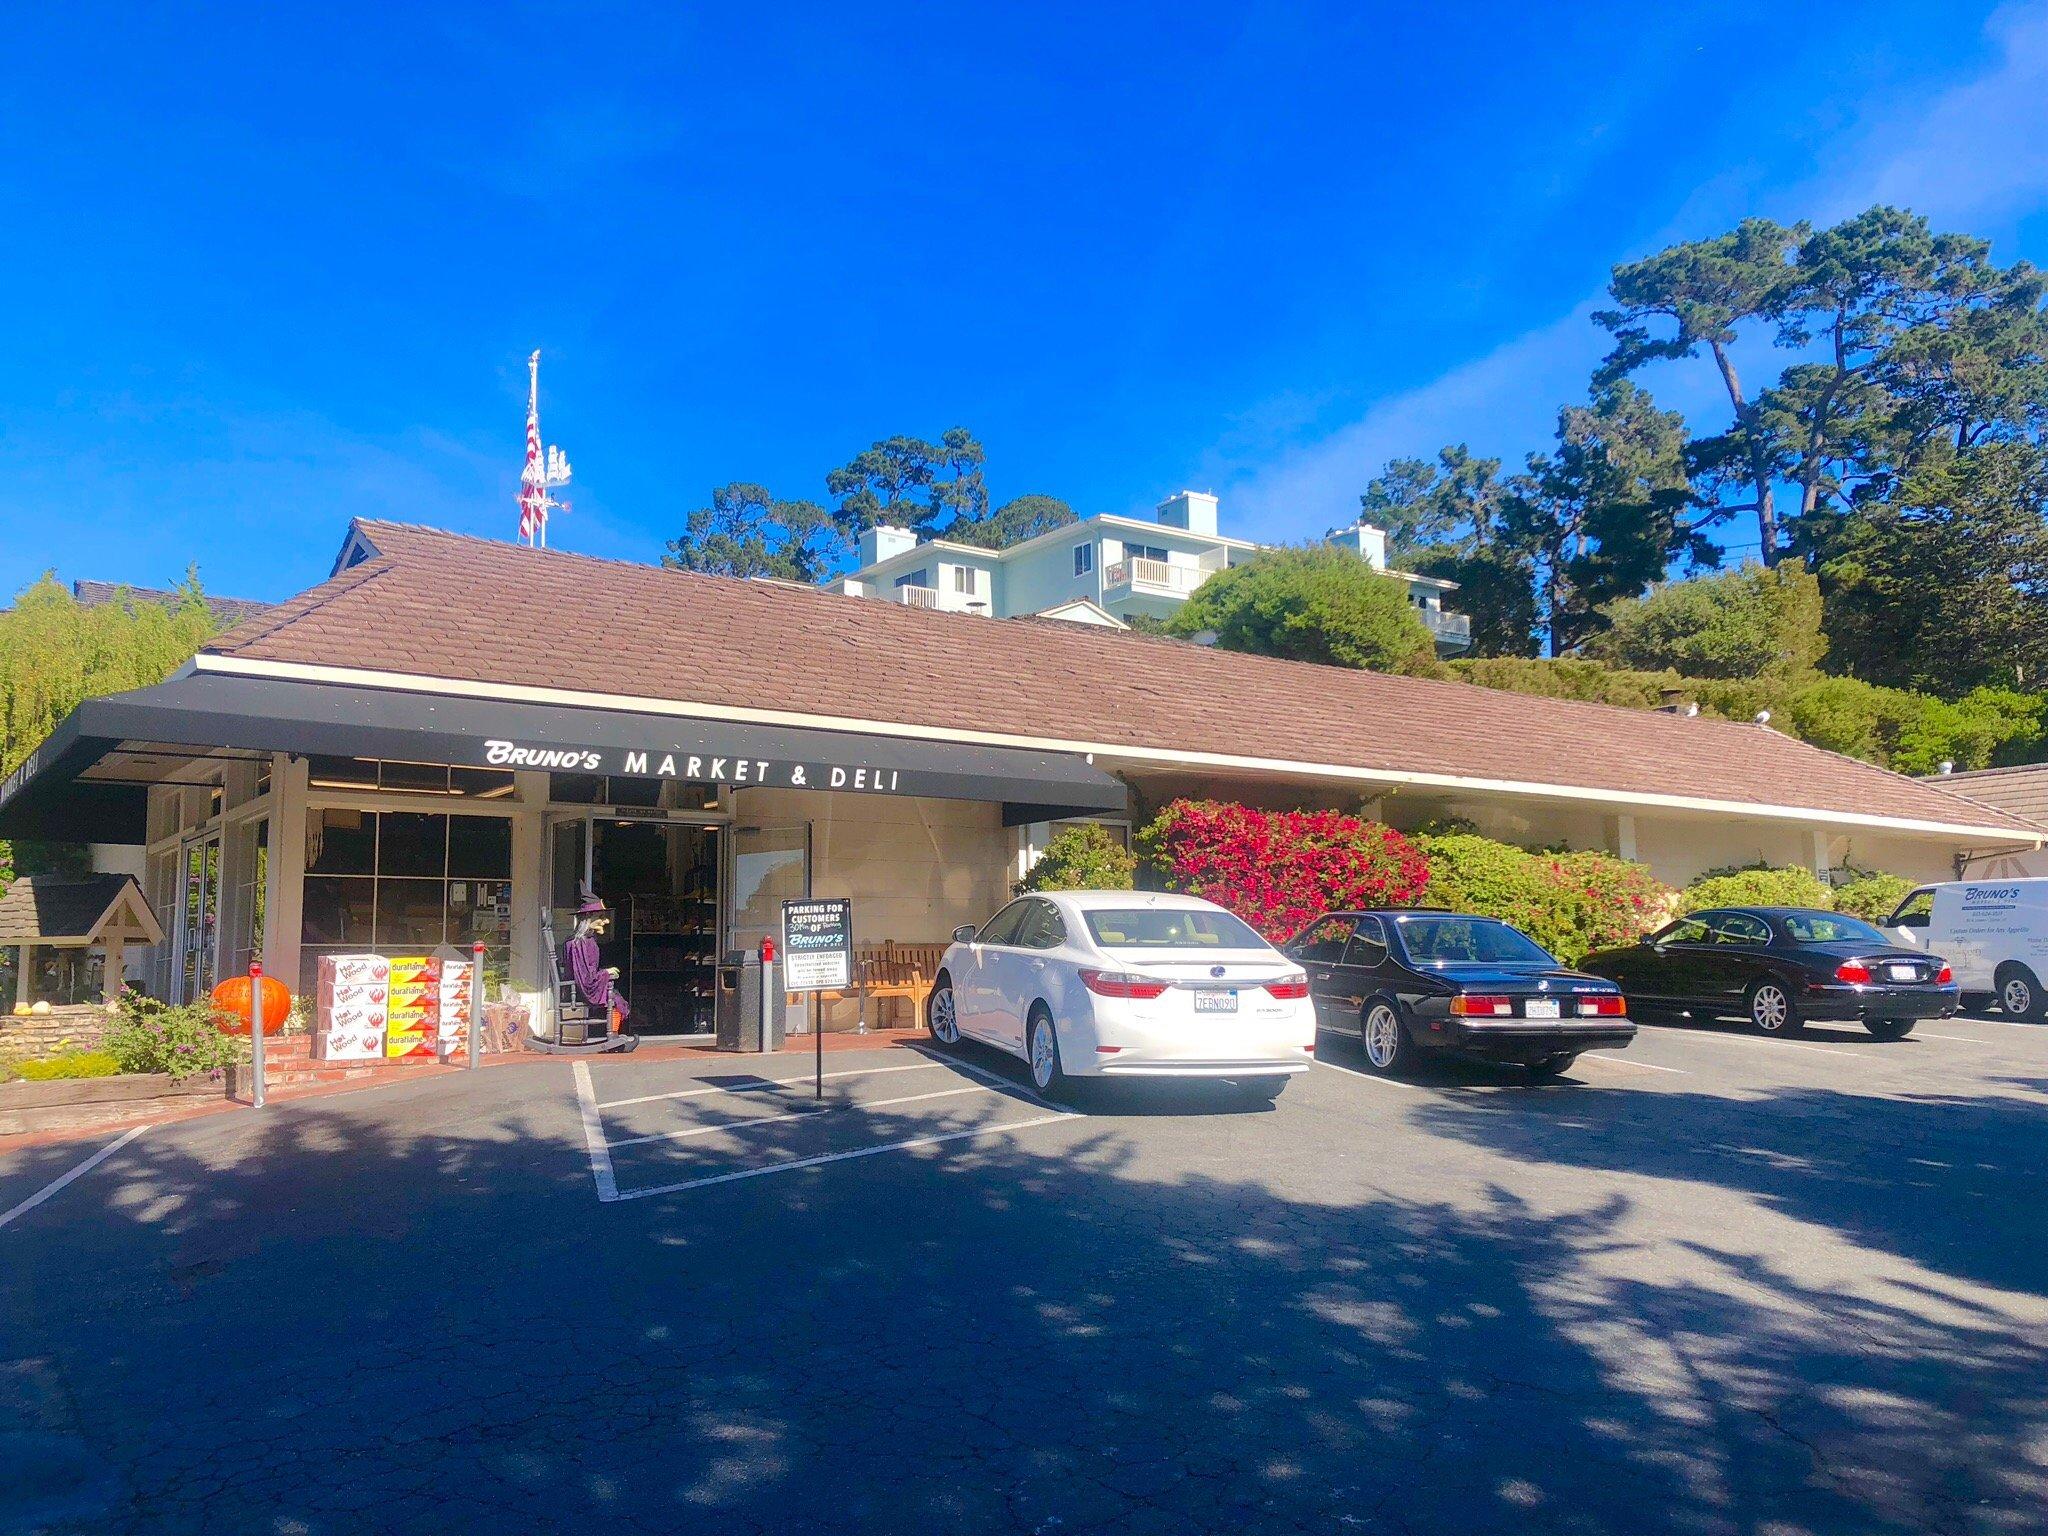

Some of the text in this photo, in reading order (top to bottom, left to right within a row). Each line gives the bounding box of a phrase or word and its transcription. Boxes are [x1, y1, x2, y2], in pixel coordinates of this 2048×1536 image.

[484, 739, 898, 791] BRUNO'S MARKET & DELI
[1965, 888, 2020, 900] BRUNO'S
[788, 904, 843, 914] PARKING FOR
[792, 913, 840, 923] CUSTOMERS
[811, 924, 821, 932] OF
[789, 934, 844, 945] BRUNO'S
[340, 962, 355, 974] Hot
[342, 963, 368, 979] Wood
[392, 962, 426, 971] duraflame
[336, 985, 352, 998] Hot
[339, 987, 364, 1003] Wood
[391, 986, 425, 995] duraflame
[335, 1009, 351, 1021] Hot
[338, 1010, 363, 1027] Wood
[390, 1010, 424, 1019] duraflame
[329, 1034, 346, 1046] Hot
[332, 1034, 358, 1052] Wood
[389, 1035, 423, 1044] duraflame
